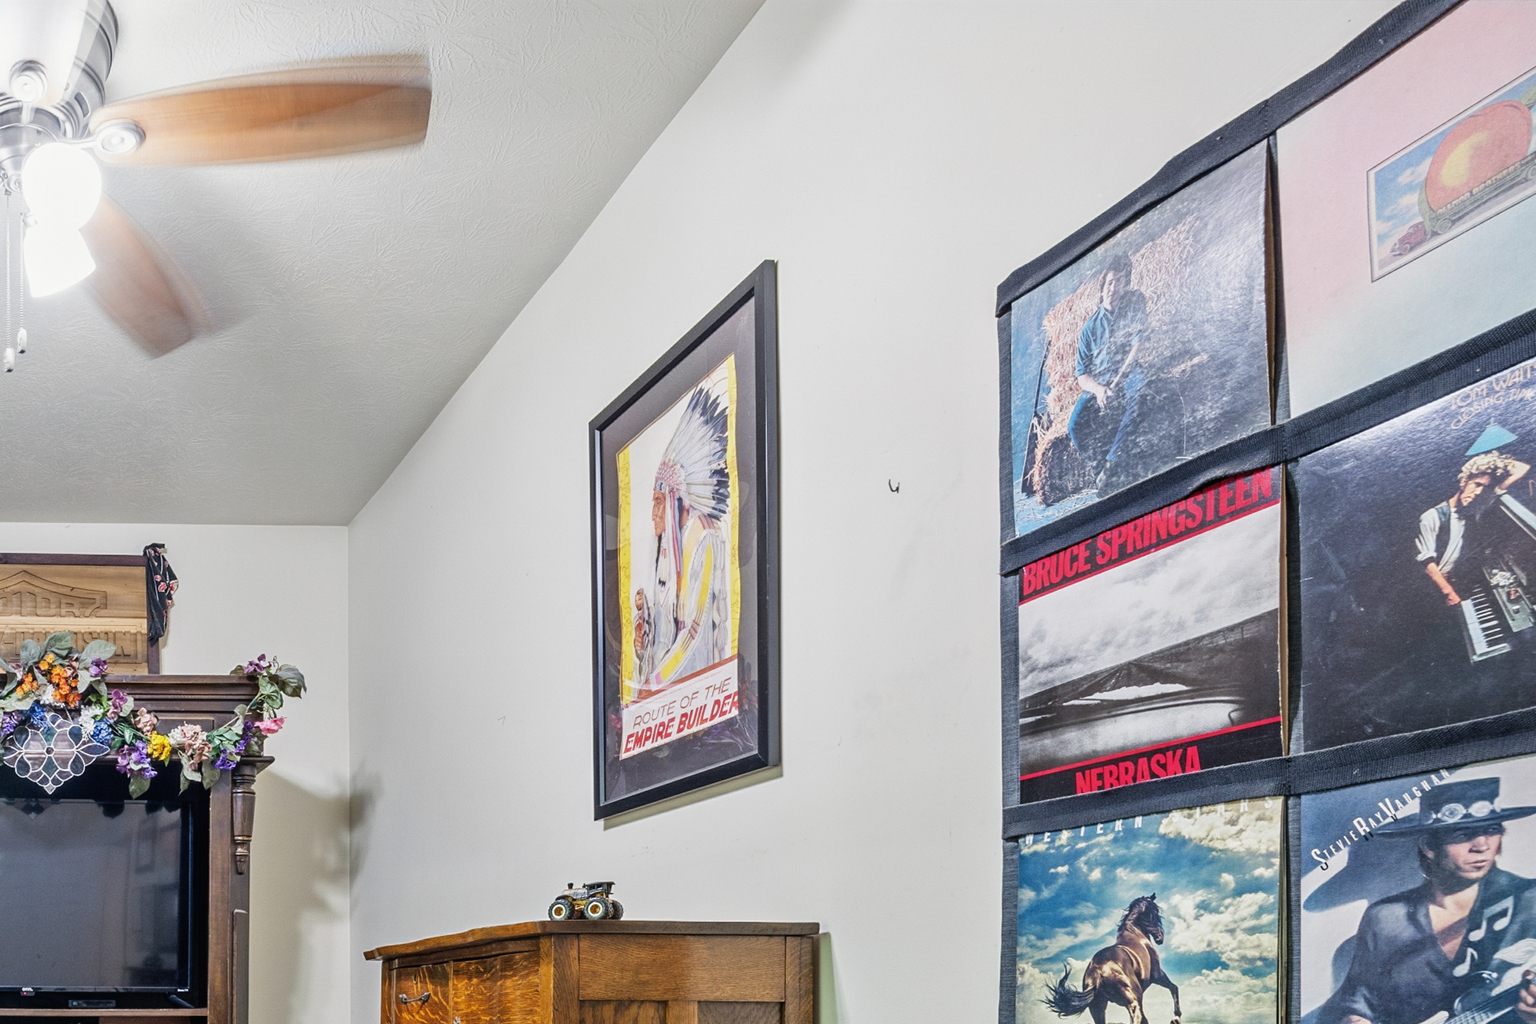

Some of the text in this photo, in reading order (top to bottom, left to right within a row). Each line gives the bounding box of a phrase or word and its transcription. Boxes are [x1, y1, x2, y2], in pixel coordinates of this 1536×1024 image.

[1450, 384, 1488, 410] TOM
[1450, 391, 1504, 430] CLOSING
[1022, 466, 1272, 596] BRUCE SPRINGSTEEN
[624, 690, 739, 754] EMPIRE BUILDER
[632, 699, 676, 729] ROUTE
[679, 690, 700, 709] OF
[704, 676, 732, 700] THE
[1075, 745, 1201, 794] NEBRASKA
